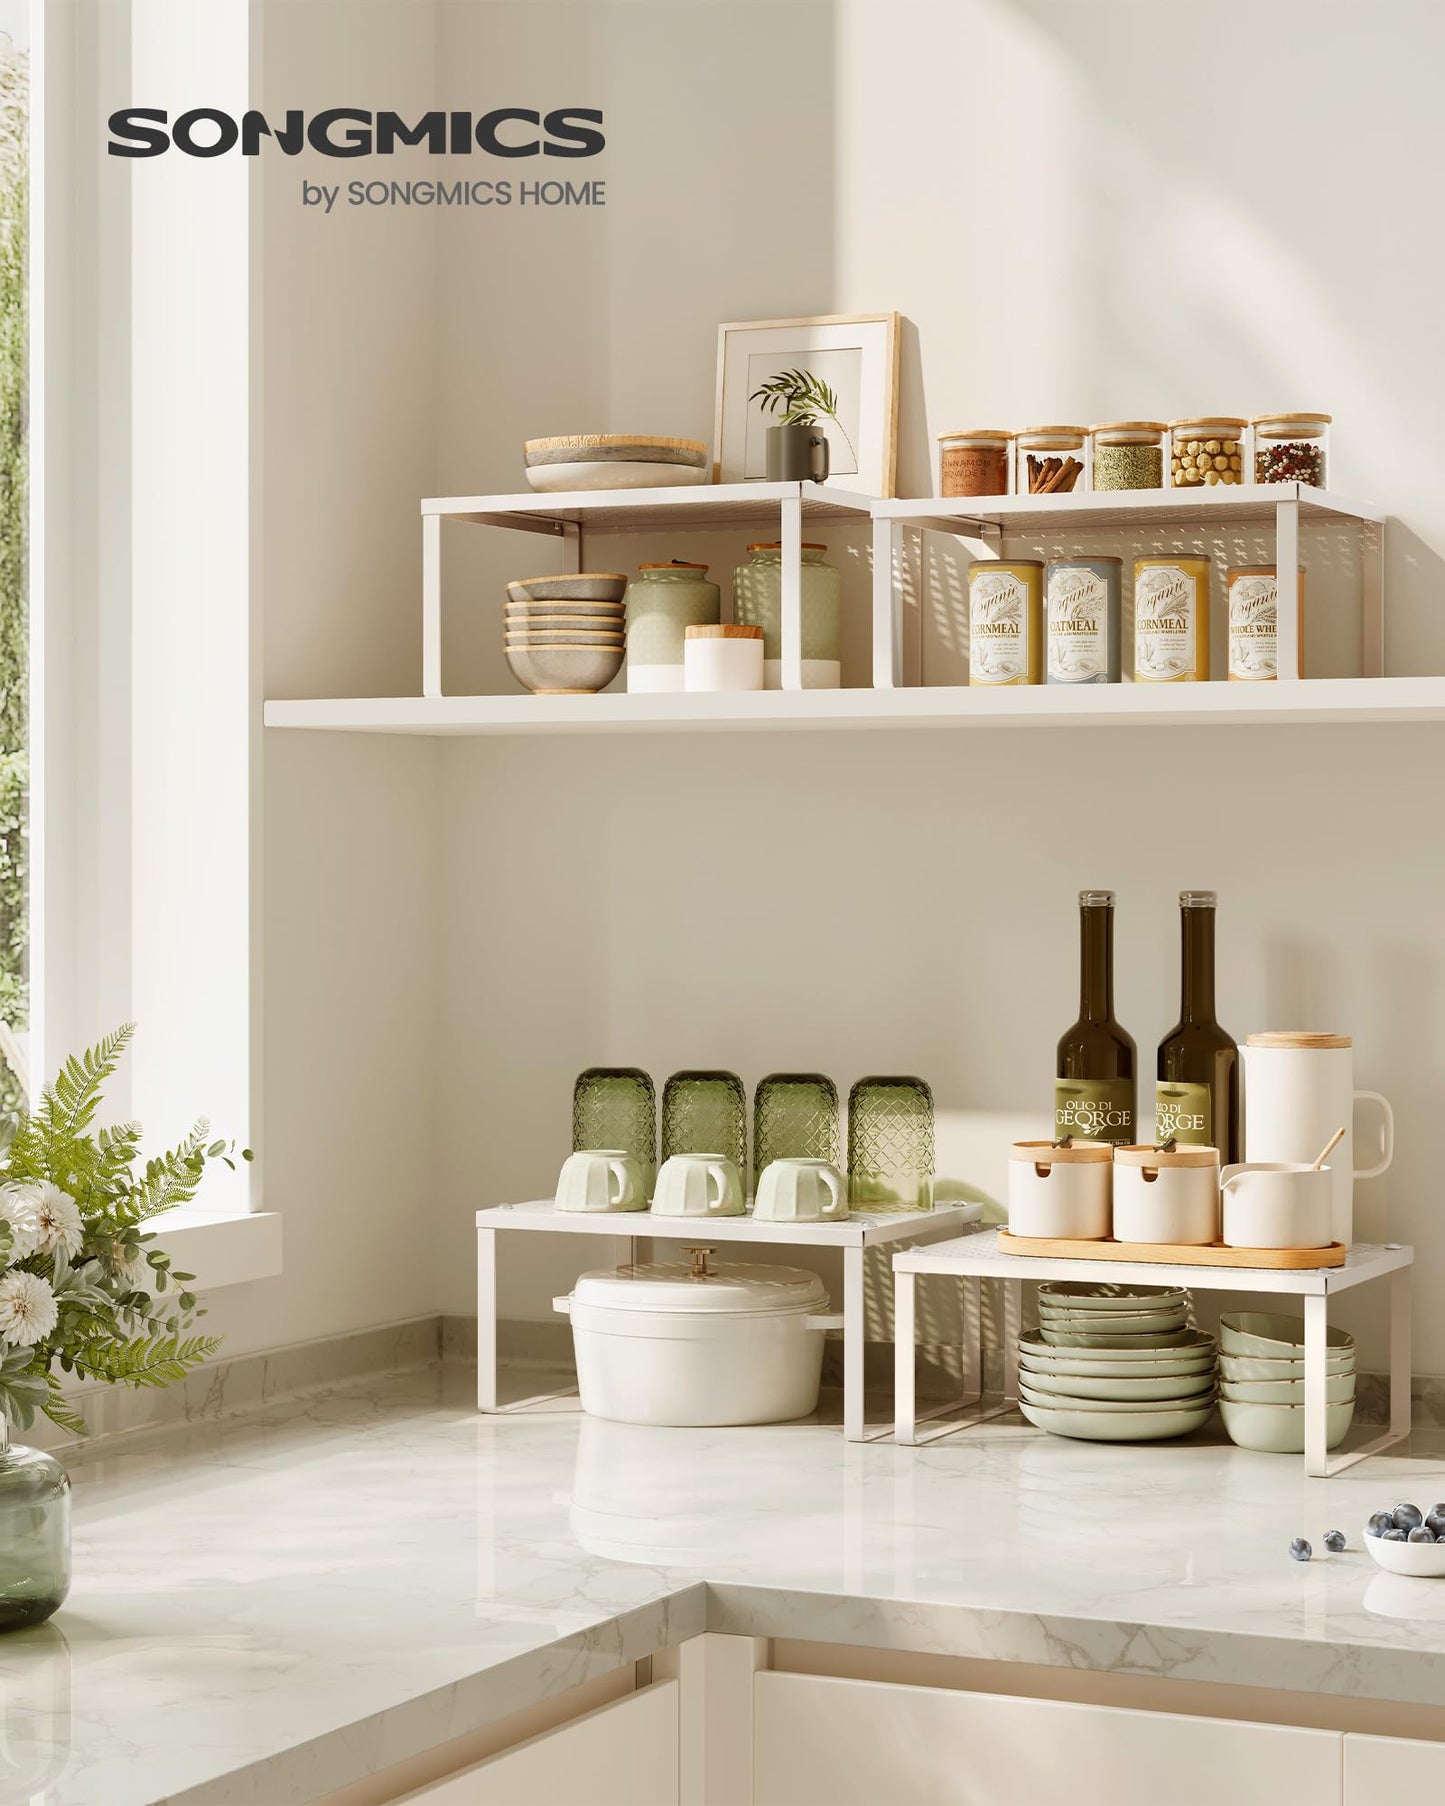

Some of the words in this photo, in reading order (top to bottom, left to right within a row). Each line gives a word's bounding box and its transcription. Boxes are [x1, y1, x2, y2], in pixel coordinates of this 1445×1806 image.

[944, 469, 987, 478] POWDER
[972, 623, 1021, 634] CORNMEAL
[1050, 620, 1098, 632] OATMEAL
[1138, 619, 1189, 630] CORNMEAL
[1231, 625, 1254, 634] WHOLE
[1256, 624, 1277, 633] WHE
[1066, 1100, 1096, 1111] OLIO
[1099, 1101, 1112, 1111] DI
[1170, 1104, 1181, 1114] DI
[1056, 1109, 1131, 1127] GEORGE
[1156, 1112, 1205, 1131] ORGE
